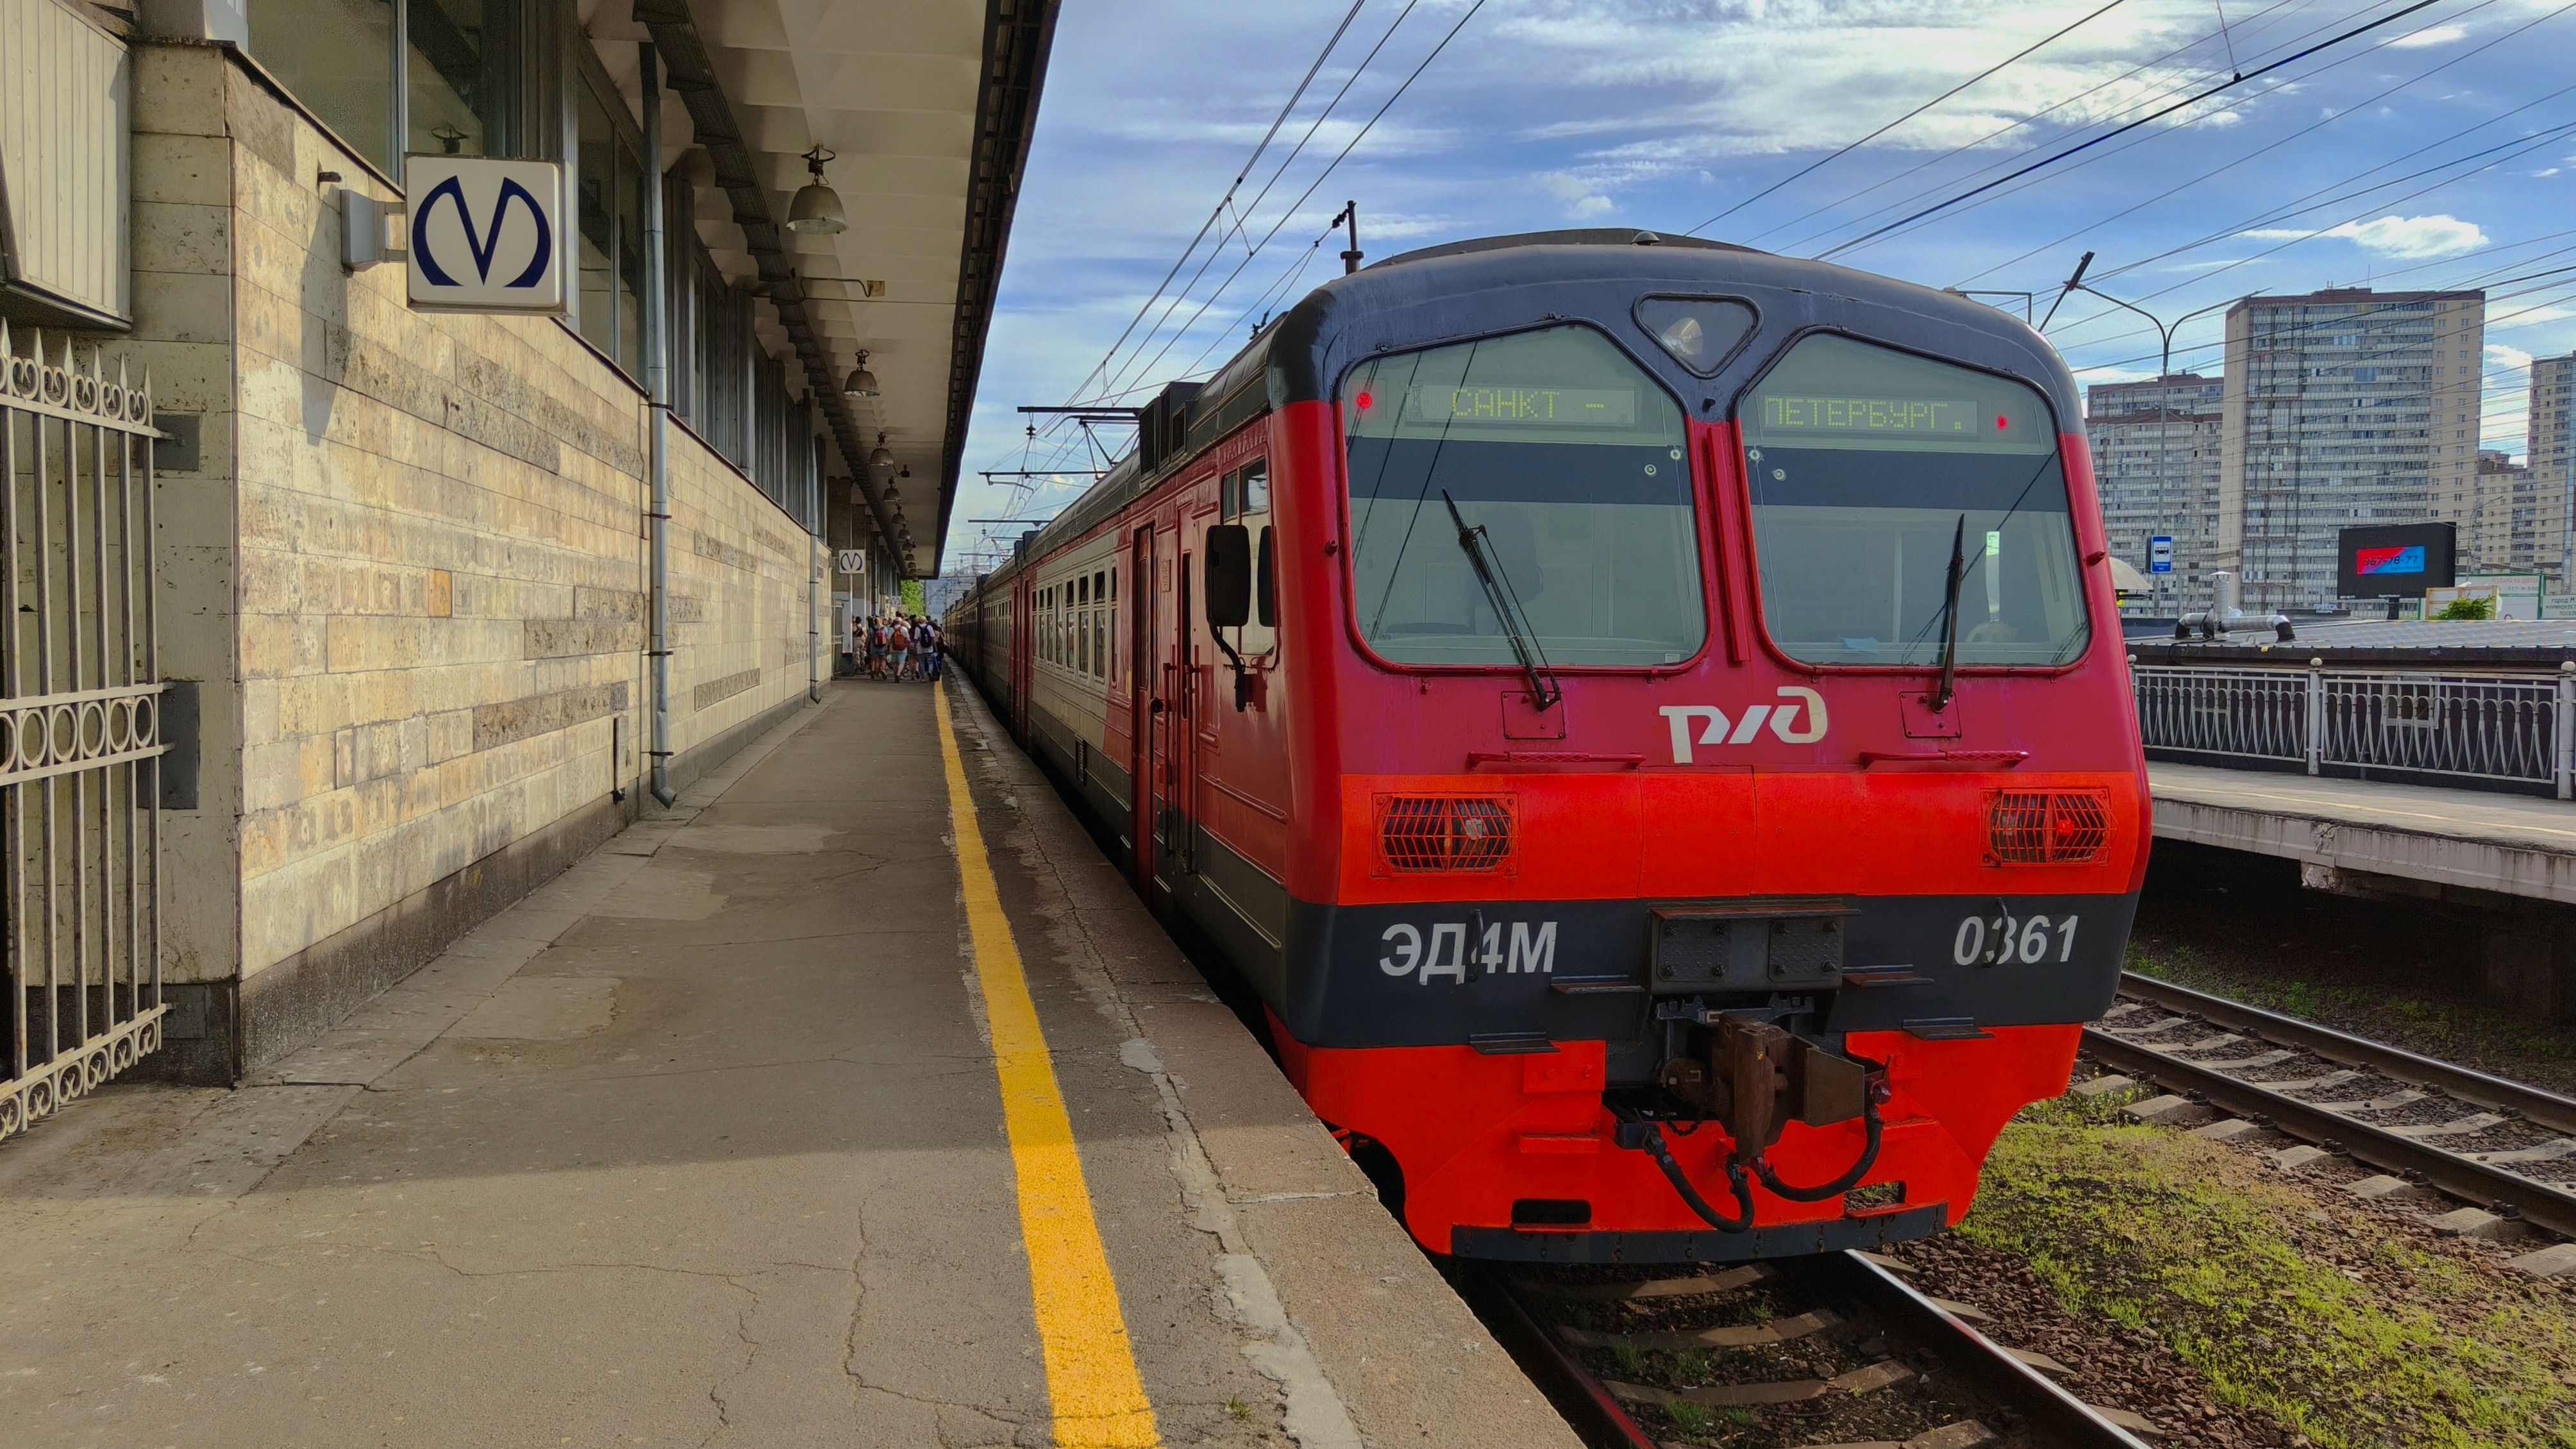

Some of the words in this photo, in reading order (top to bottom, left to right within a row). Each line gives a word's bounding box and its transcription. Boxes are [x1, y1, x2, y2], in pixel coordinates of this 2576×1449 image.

[1451, 388, 1560, 419] САНКТ
[1379, 921, 1558, 985] ЭД4М
[1953, 914, 2078, 966] 0361
